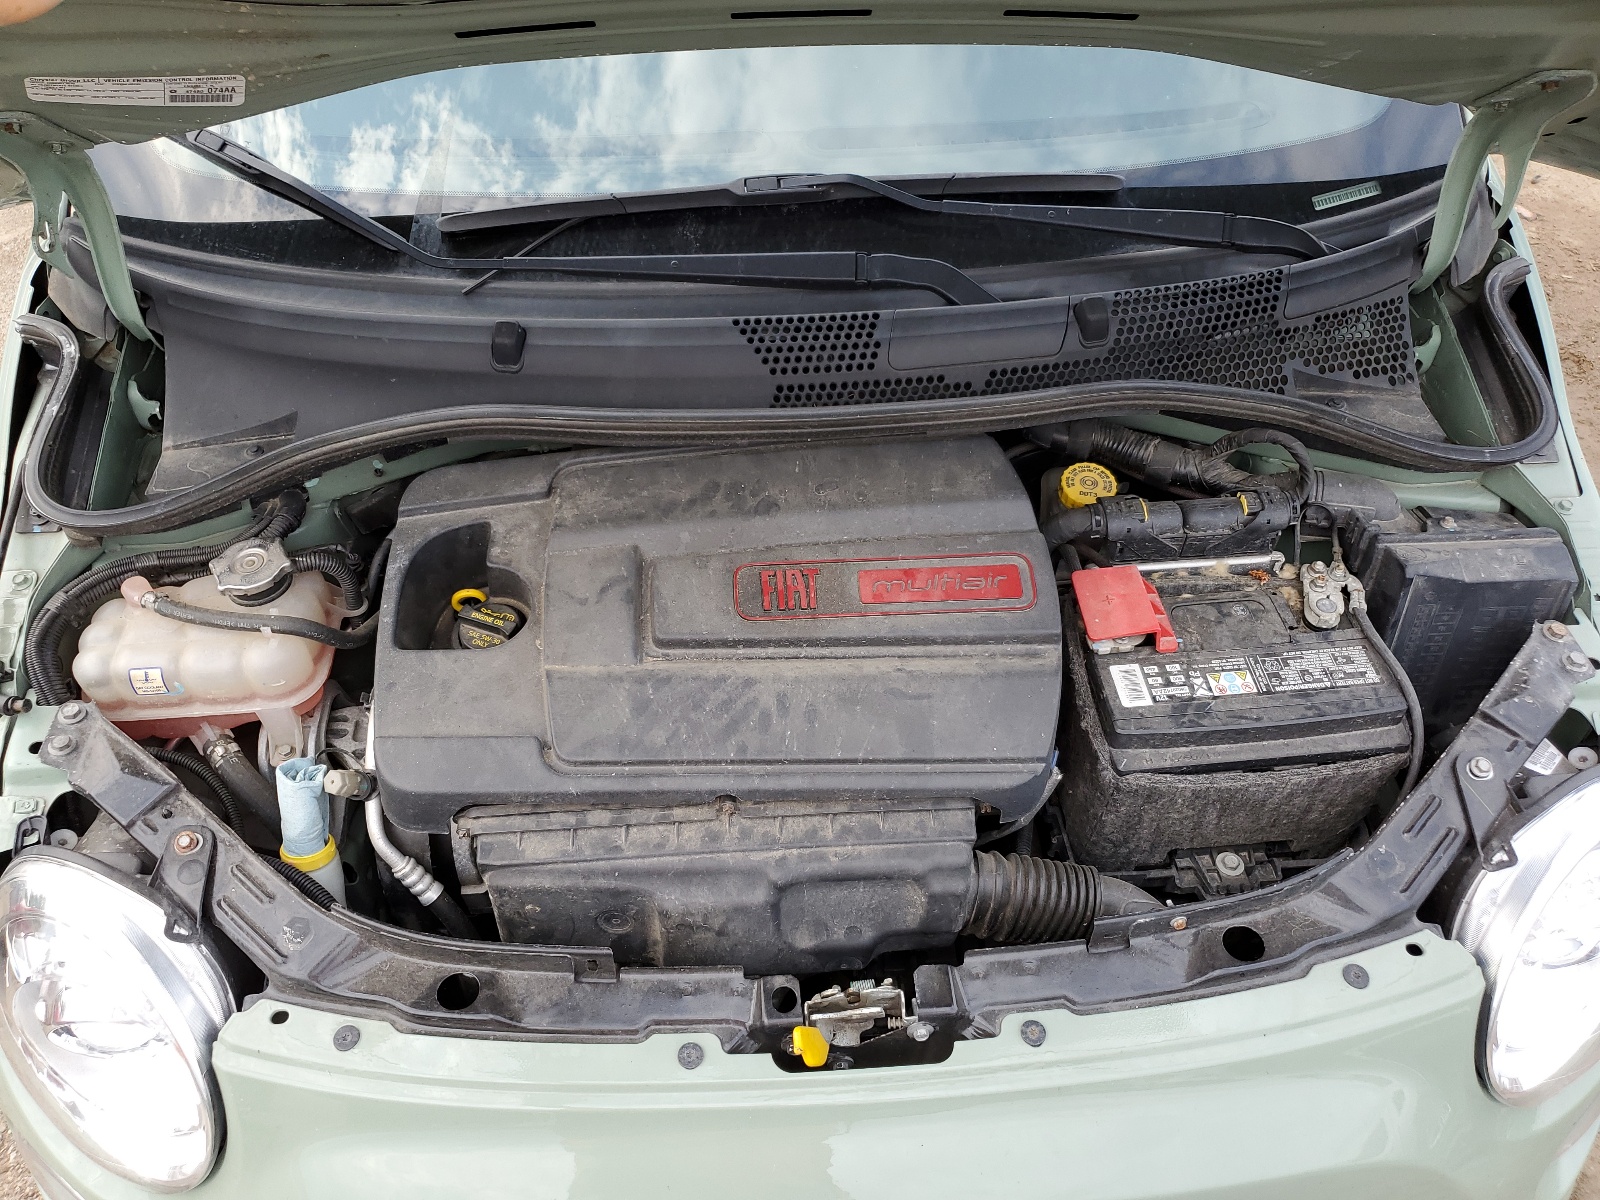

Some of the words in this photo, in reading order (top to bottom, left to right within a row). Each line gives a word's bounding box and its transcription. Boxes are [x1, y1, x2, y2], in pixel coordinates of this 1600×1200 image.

[760, 568, 820, 611] FIAT
[872, 571, 1008, 593] multiair
[471, 611, 494, 623] ENGINE
[493, 618, 505, 627] OIL
[467, 630, 480, 639] SAE
[472, 638, 490, 648] ONLY
